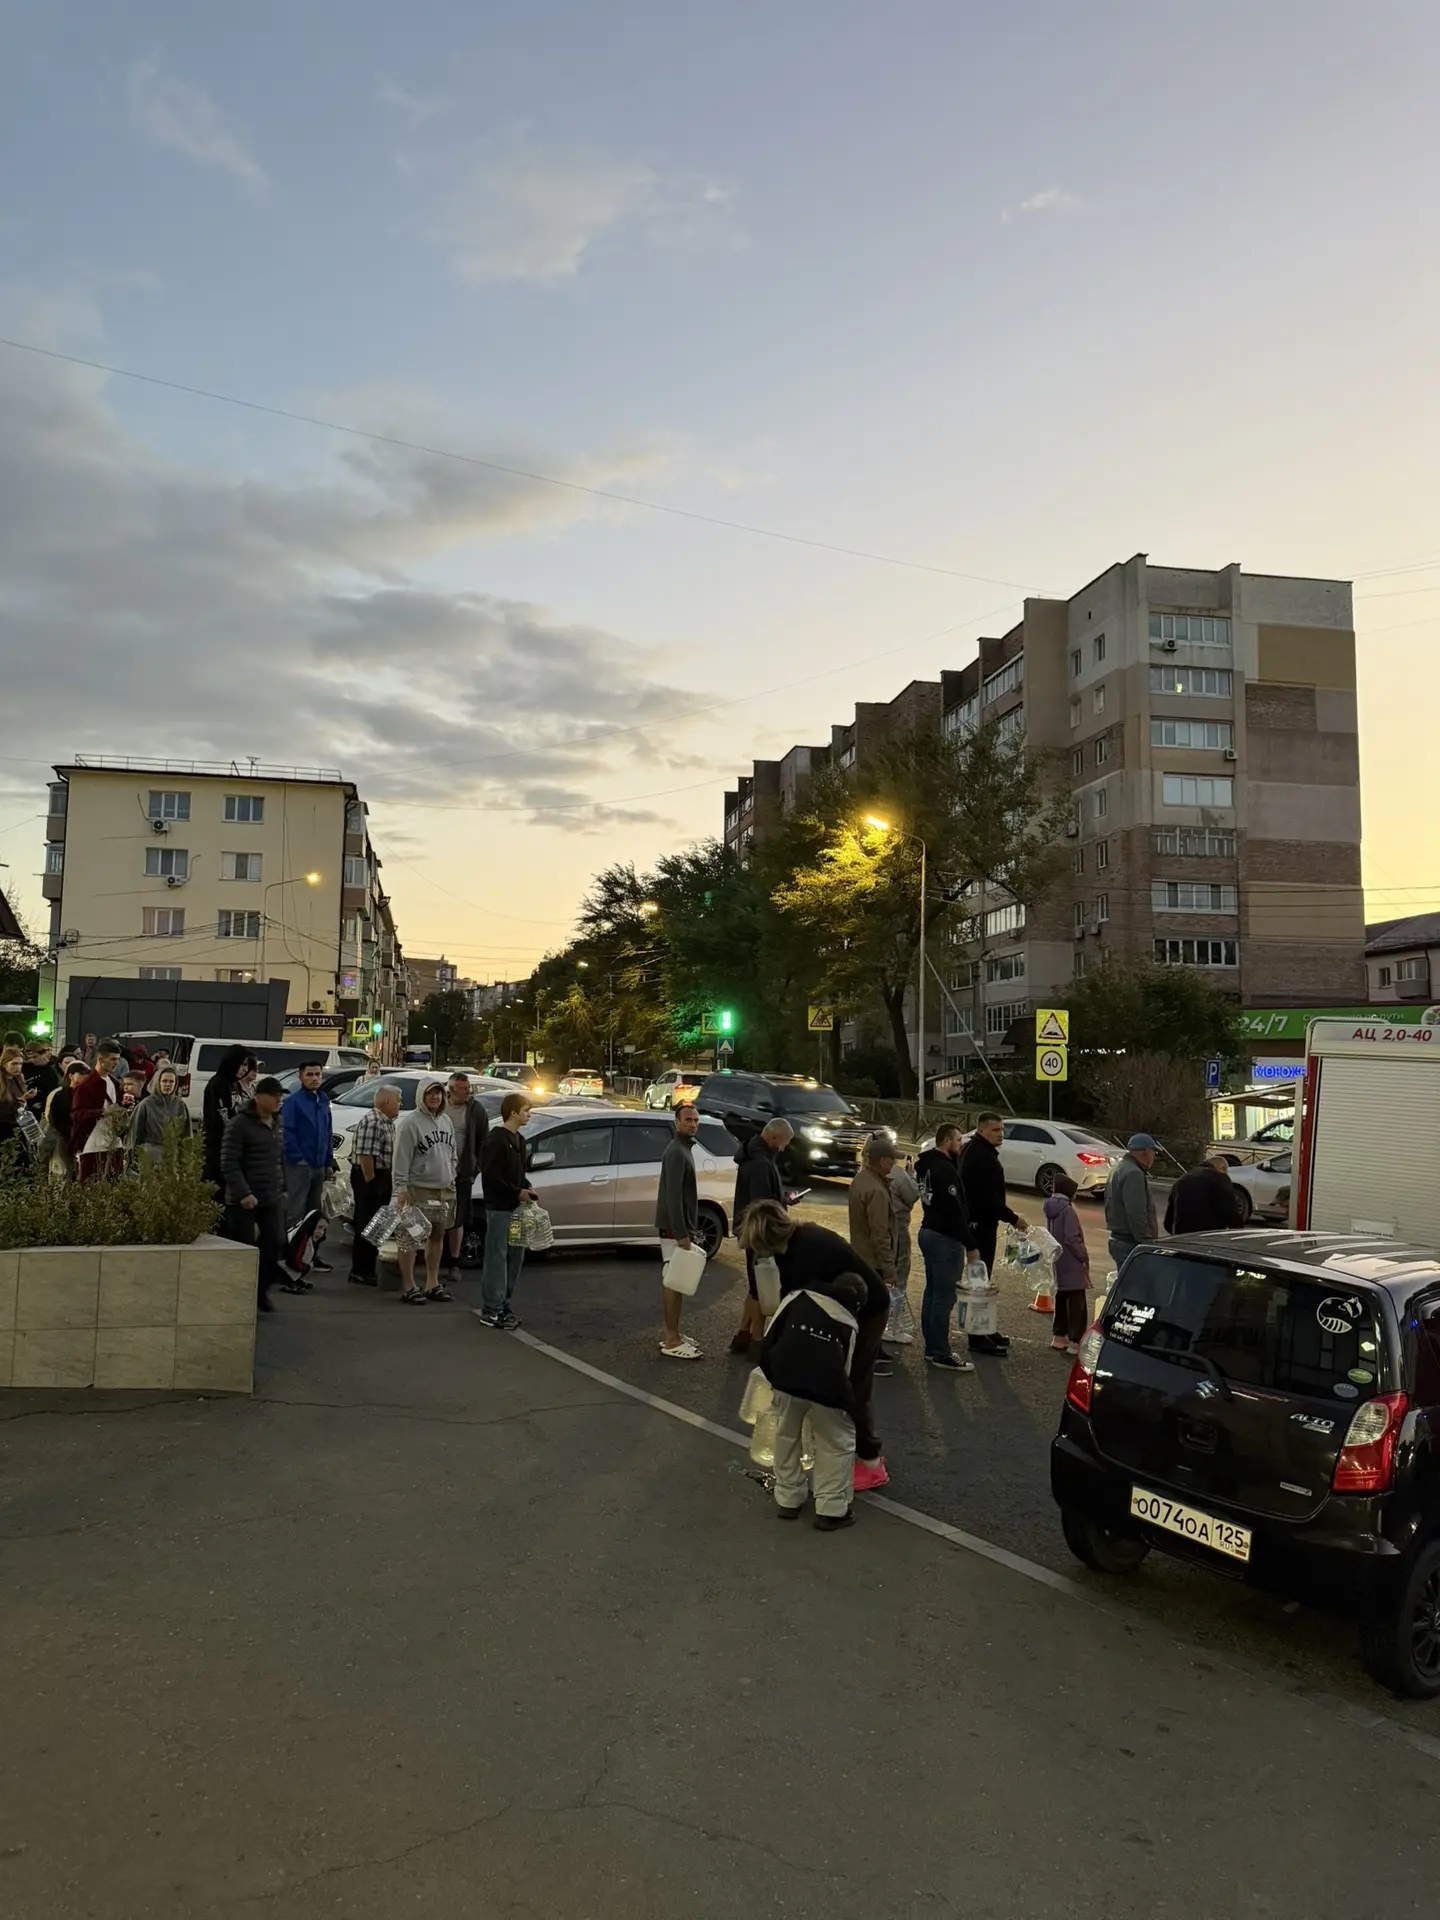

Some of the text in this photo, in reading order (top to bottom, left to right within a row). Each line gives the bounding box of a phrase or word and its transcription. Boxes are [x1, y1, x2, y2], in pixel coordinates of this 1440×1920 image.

[307, 1017, 335, 1026] VITA
[1238, 1013, 1288, 1035] 24/7
[1352, 1027, 1432, 1042] АЦ 2,0-40
[1045, 1057, 1058, 1069] 40
[1208, 1063, 1218, 1083] P
[1290, 1413, 1335, 1429] ALTO
[1215, 1523, 1244, 1548] 125
[1220, 1540, 1235, 1552] RUS
